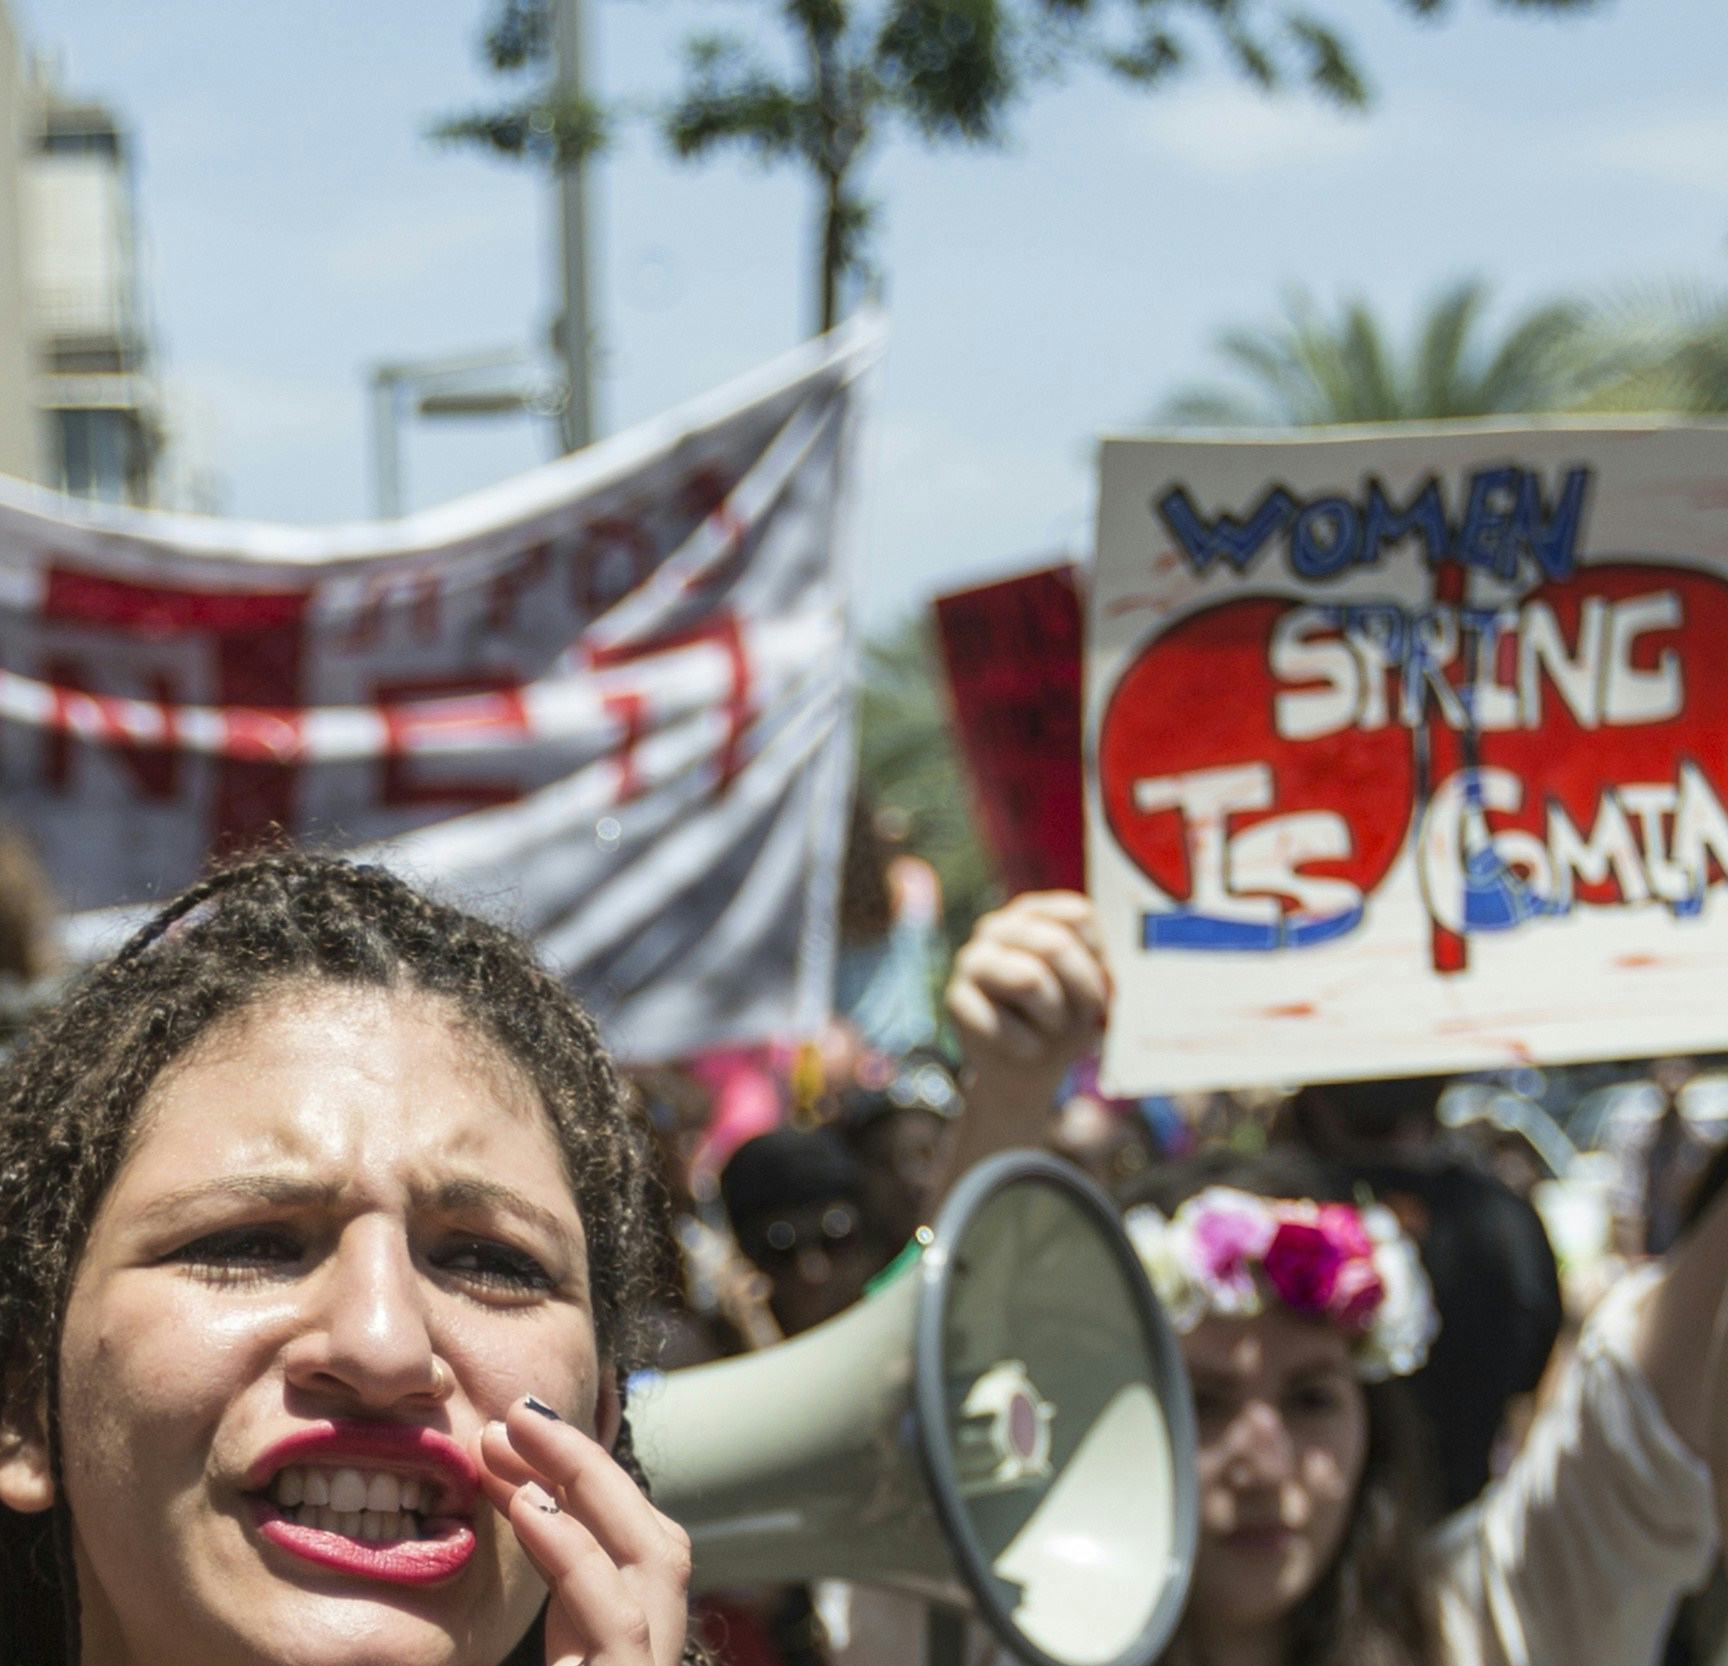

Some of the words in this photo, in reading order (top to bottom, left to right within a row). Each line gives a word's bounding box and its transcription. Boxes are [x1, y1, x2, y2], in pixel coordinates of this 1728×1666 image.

[1156, 462, 1594, 582] WOMEN
[1268, 592, 1686, 742] SPRING
[1134, 764, 1364, 950] IS
